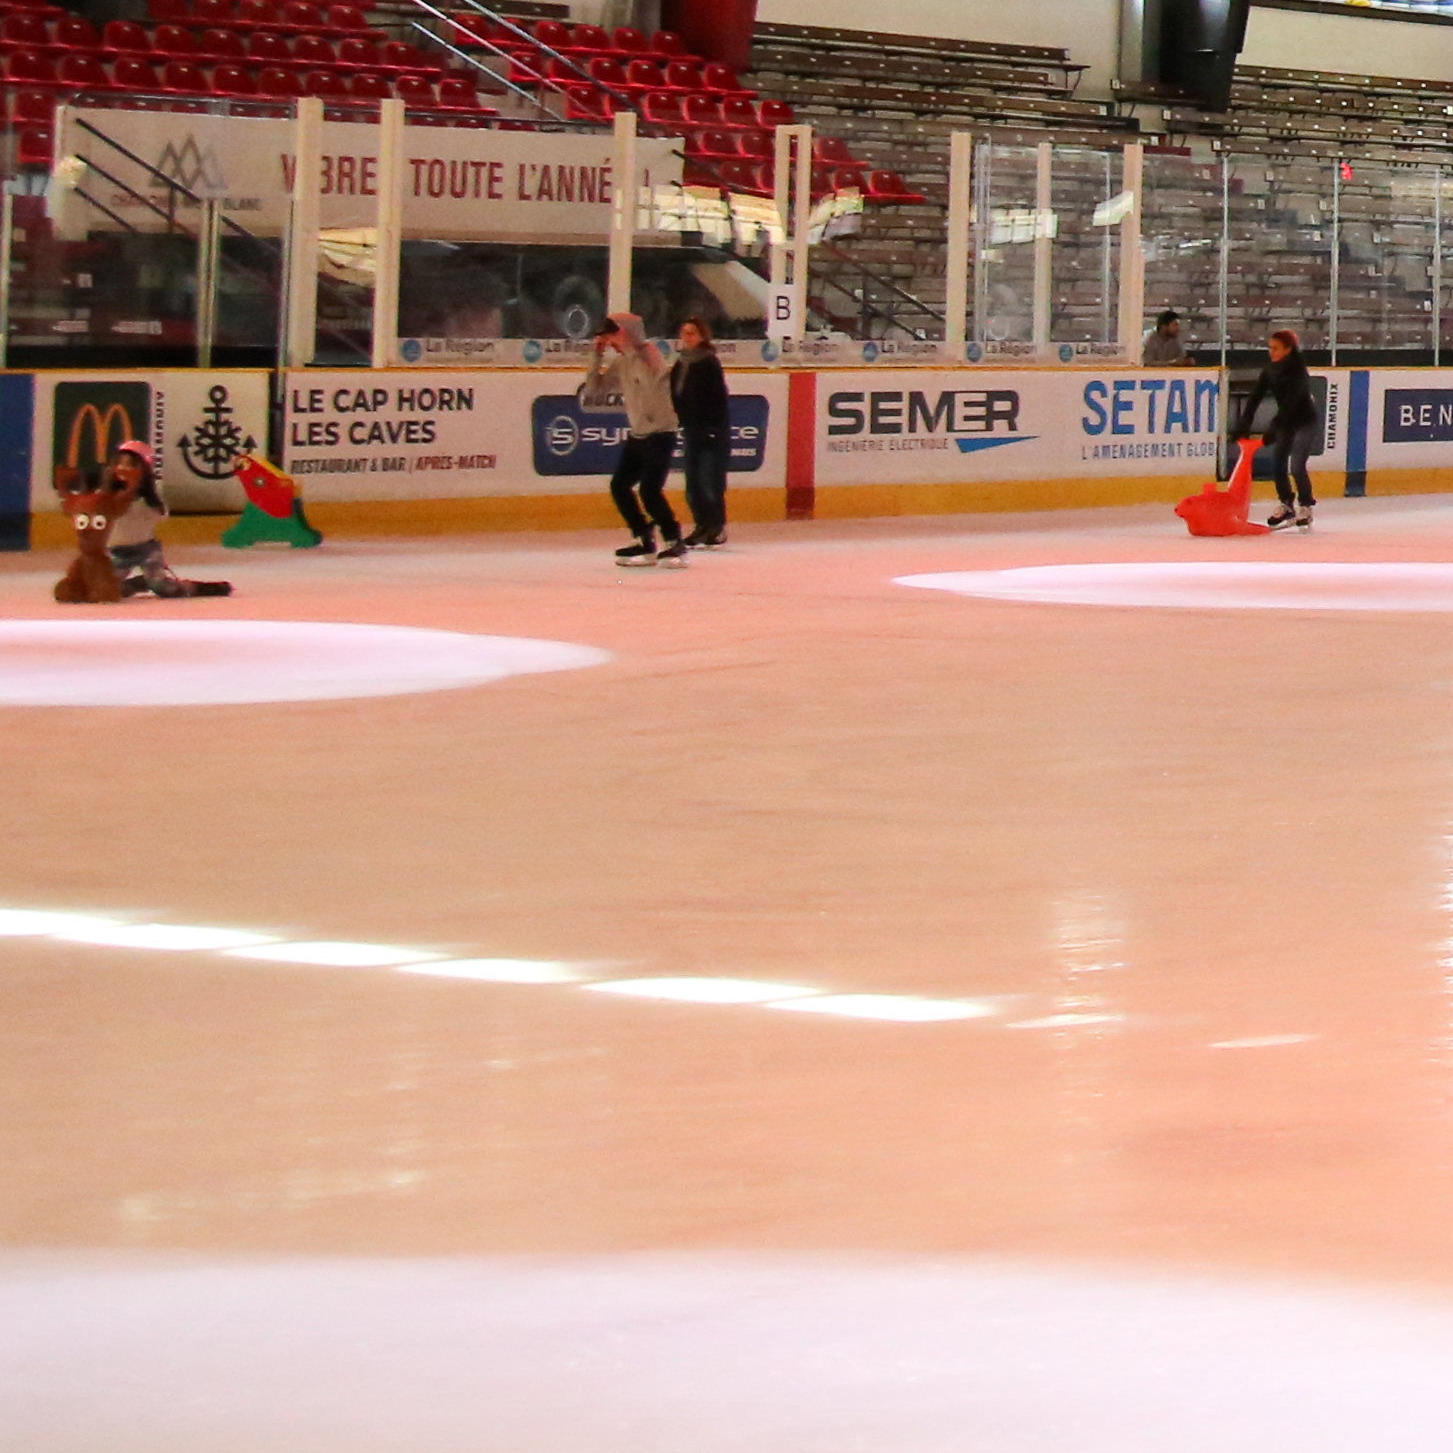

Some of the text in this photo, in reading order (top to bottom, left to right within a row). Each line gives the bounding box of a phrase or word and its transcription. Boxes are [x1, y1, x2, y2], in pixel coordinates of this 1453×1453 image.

[281, 152, 378, 196] VBRE
[410, 158, 503, 200] TOUTE
[518, 158, 612, 204] L'ANNÉ
[776, 295, 791, 320] B
[292, 388, 474, 414] LE CAP HORN
[827, 389, 1019, 435] SEMER
[1327, 383, 1339, 450] CHAMONIX
[291, 420, 436, 446] LES CAVES
[1186, 441, 1217, 457] GLOB
[291, 457, 367, 475] RESTAURANT
[382, 456, 406, 472] BAR
